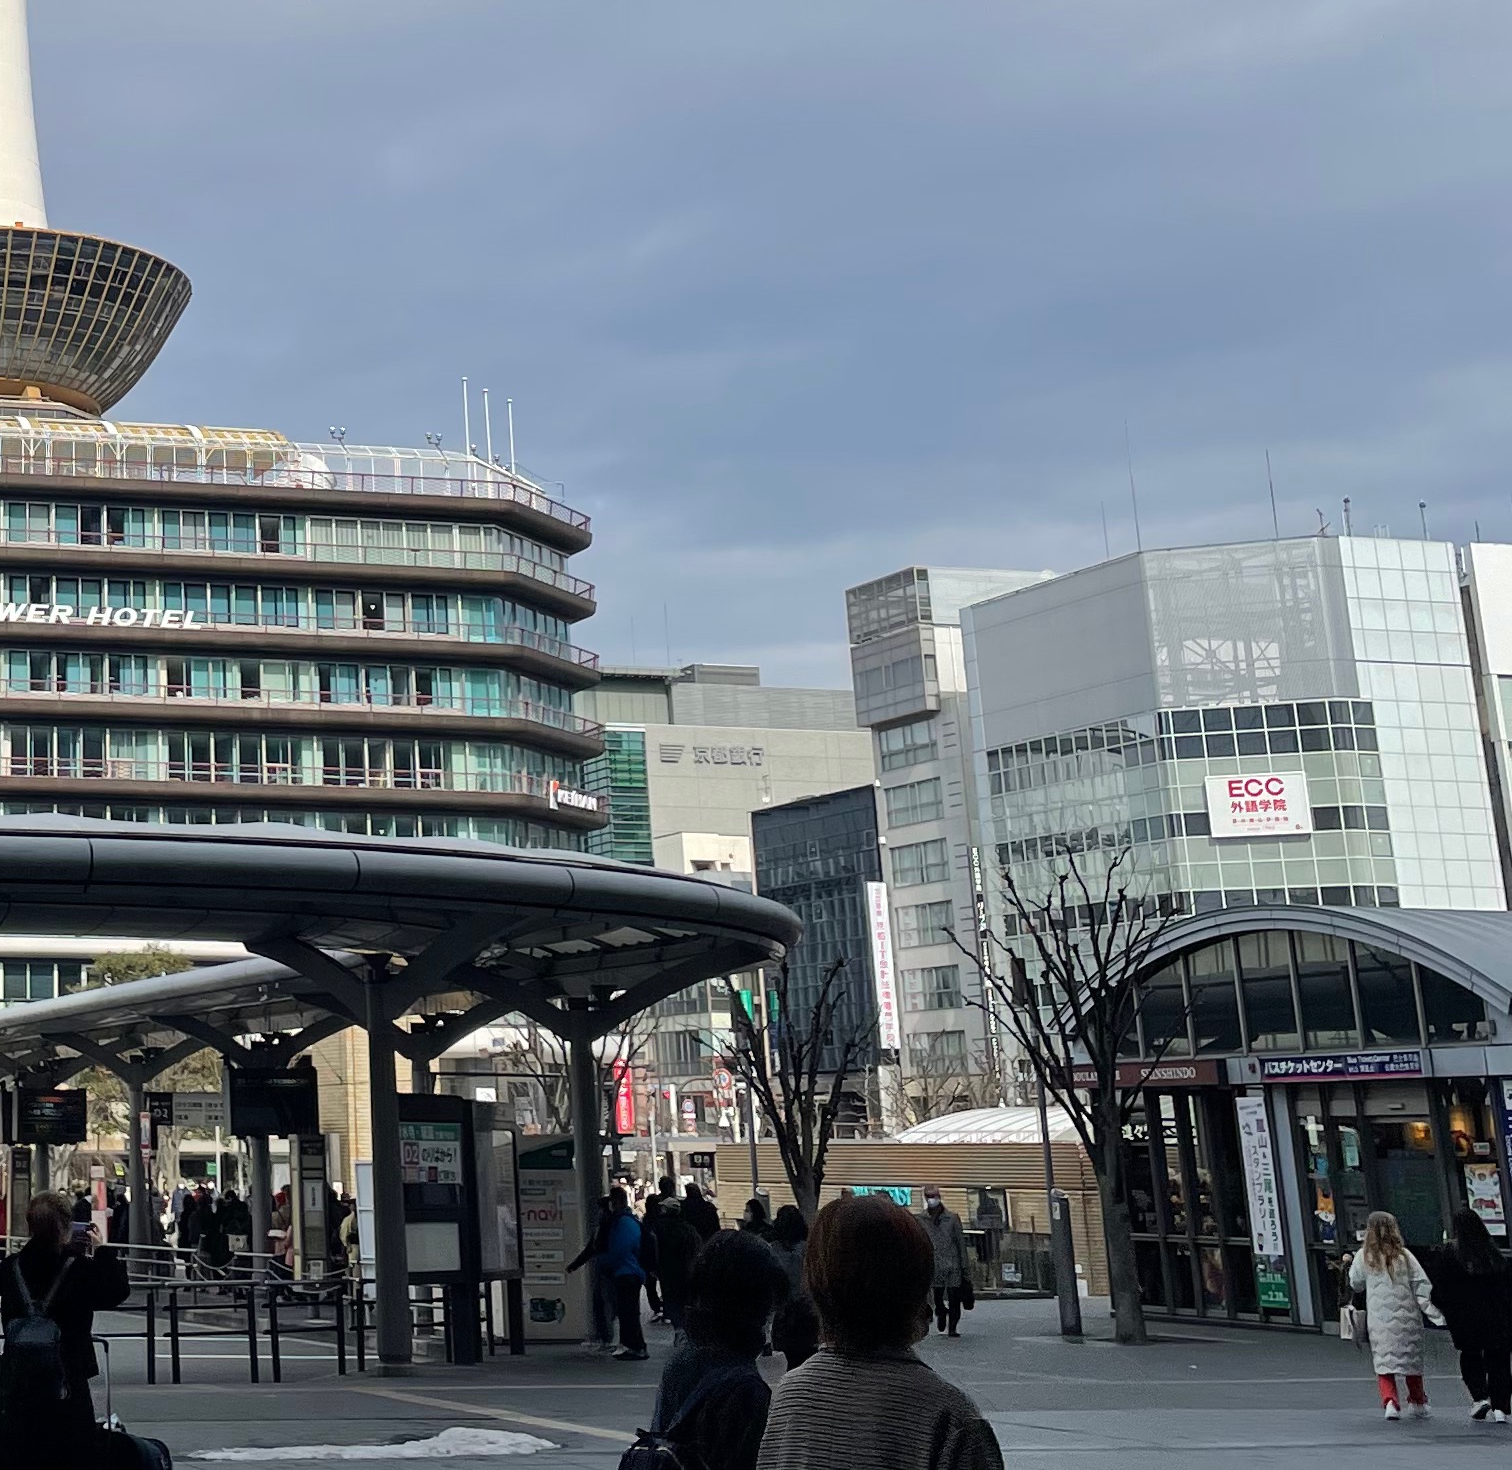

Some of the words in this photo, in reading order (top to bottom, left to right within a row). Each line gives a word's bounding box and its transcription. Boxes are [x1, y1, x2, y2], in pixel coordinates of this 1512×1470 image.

[86, 606, 202, 630] HOTEL
[693, 746, 765, 766] 京都銀行
[1228, 778, 1285, 798] ECC
[1230, 799, 1288, 813] 外語学院
[1264, 1059, 1343, 1075] バスチケットセンター
[405, 1144, 419, 1163] D2
[1252, 1145, 1267, 1231] スタンプラリー
